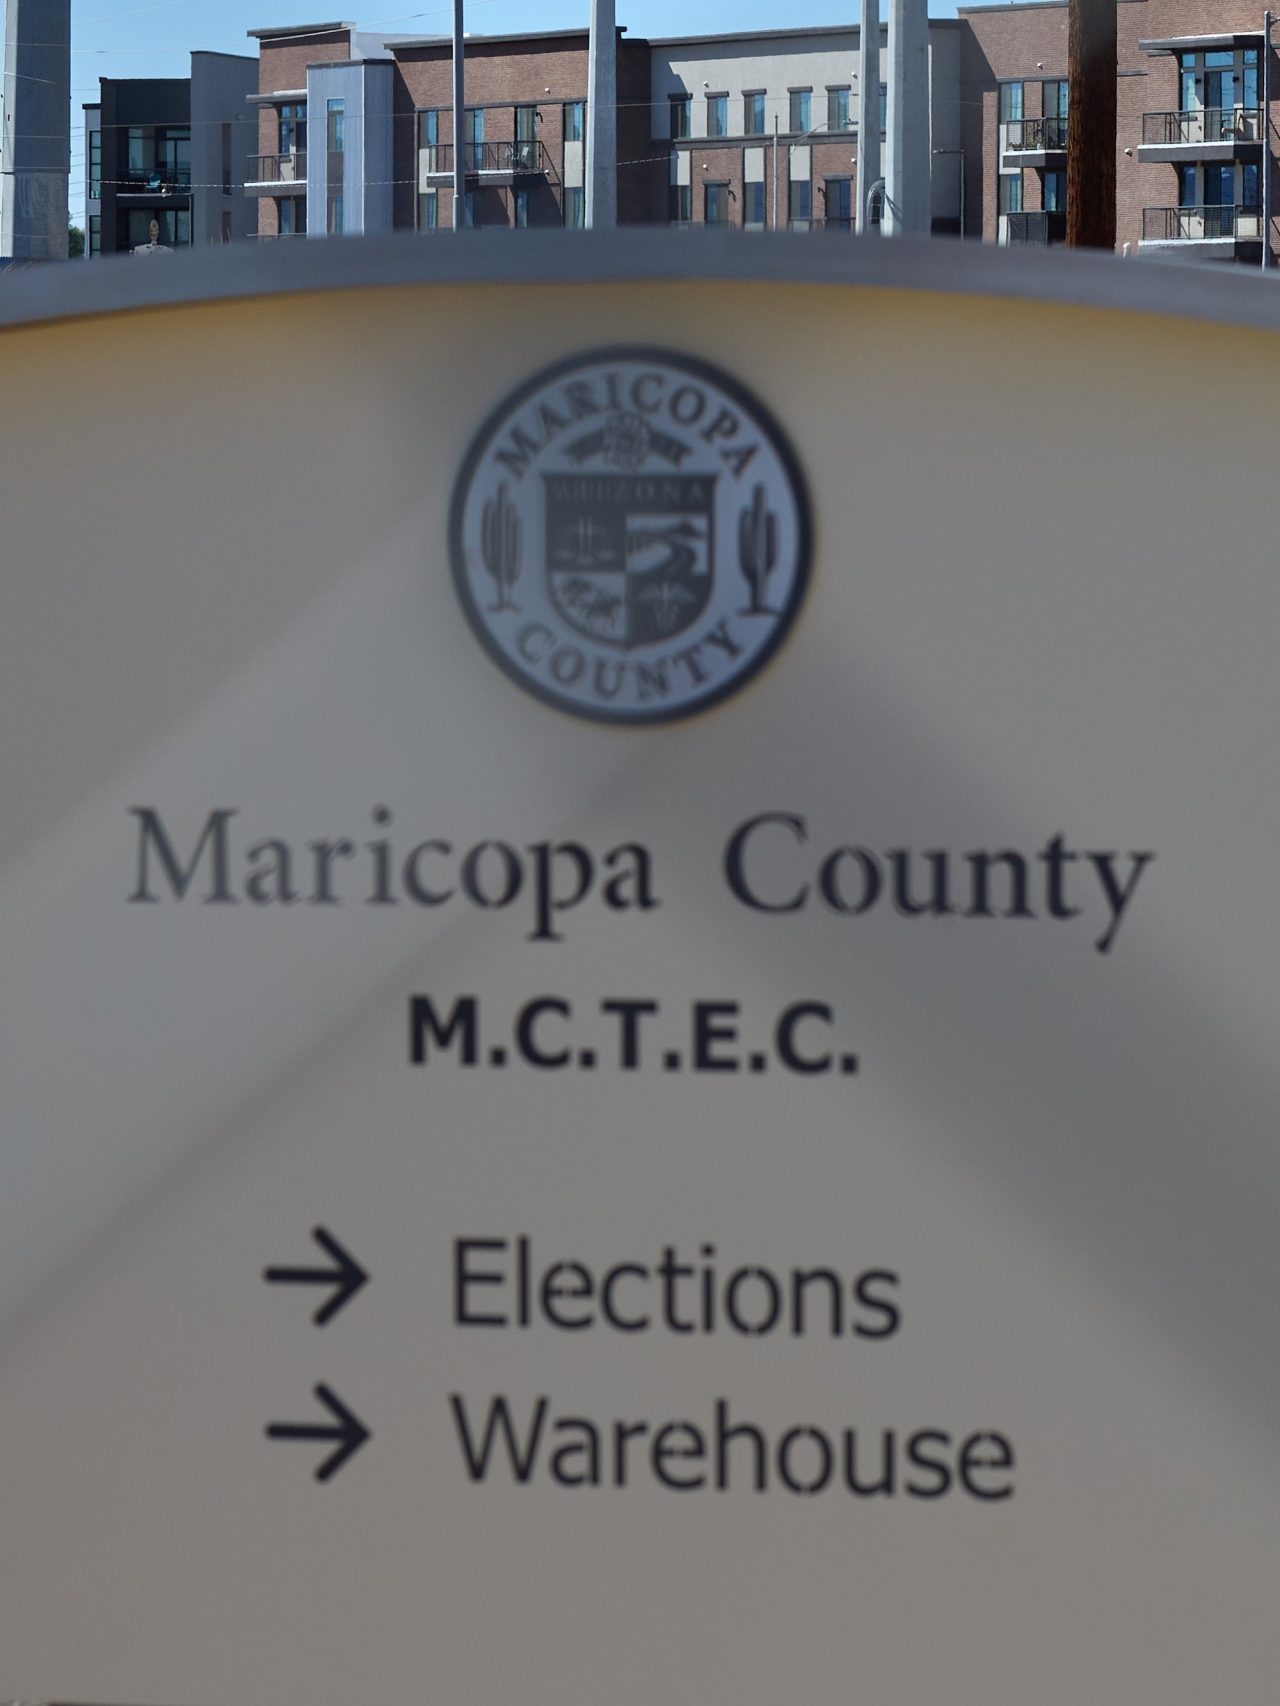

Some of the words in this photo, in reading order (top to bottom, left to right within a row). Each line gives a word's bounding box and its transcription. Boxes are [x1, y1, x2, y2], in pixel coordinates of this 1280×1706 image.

[494, 371, 760, 482] MARICOPA
[515, 616, 746, 700] COUNTY
[126, 806, 660, 942] Maricopa
[723, 812, 1155, 956] County
[408, 994, 859, 1076] M.C.T.E.C.
[453, 1235, 901, 1340] Elections
[448, 1392, 1016, 1502] Warehouse
